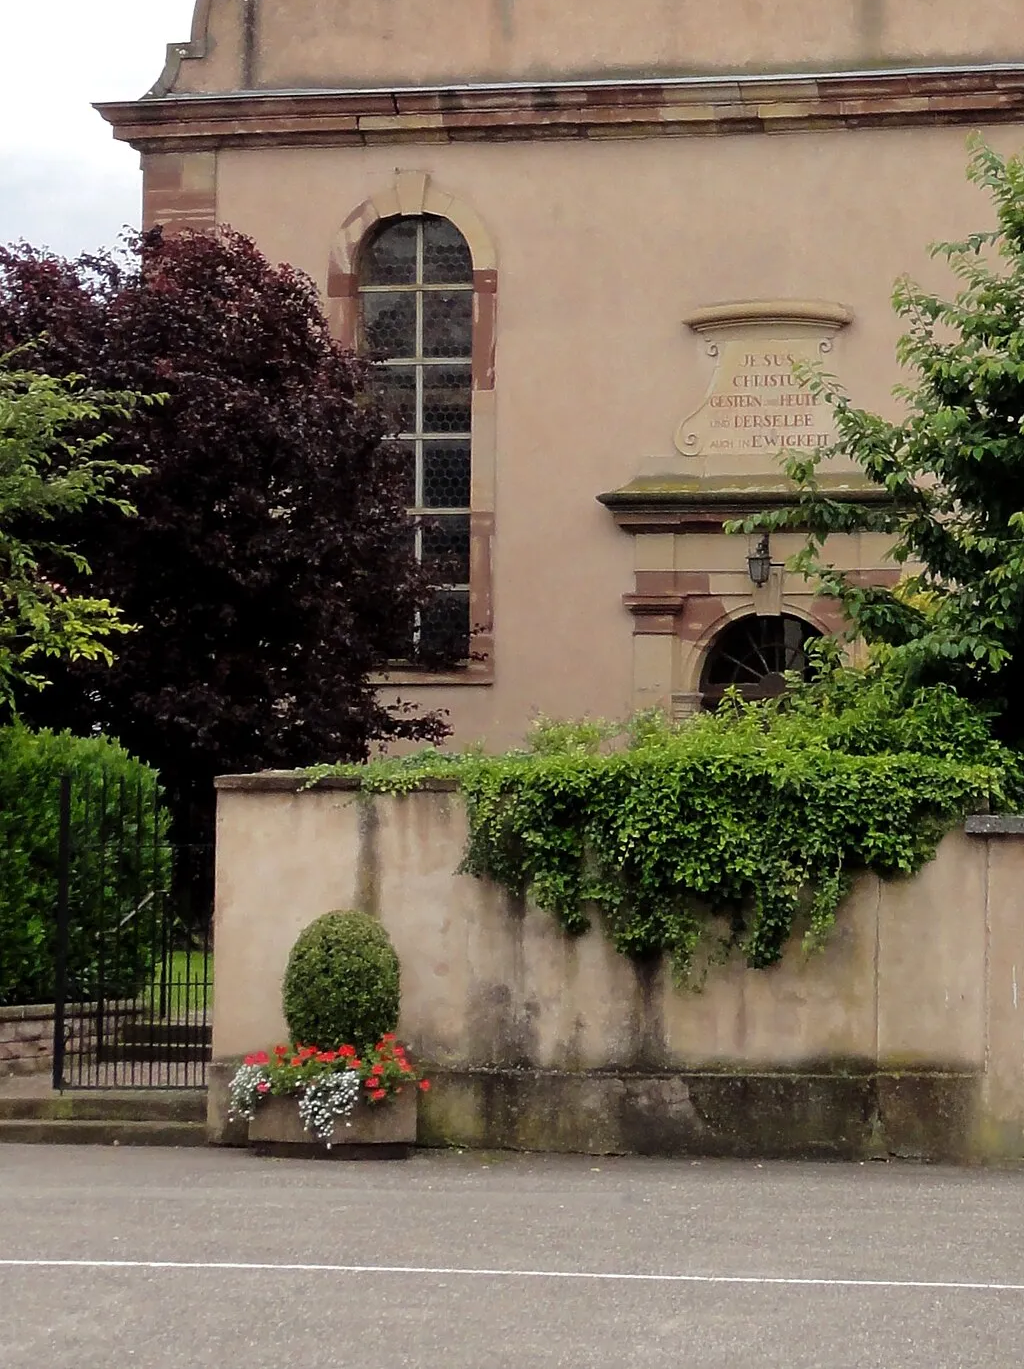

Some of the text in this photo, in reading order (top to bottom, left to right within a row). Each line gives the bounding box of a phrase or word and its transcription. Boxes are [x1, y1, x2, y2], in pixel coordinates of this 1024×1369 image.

[740, 354, 796, 367] JESUS
[732, 374, 799, 388] CHRISTU
[709, 394, 764, 408] GESTERN
[780, 393, 820, 407] HEUTE
[734, 414, 814, 428] DERSELBE
[751, 433, 830, 448] EWIGKEIT
